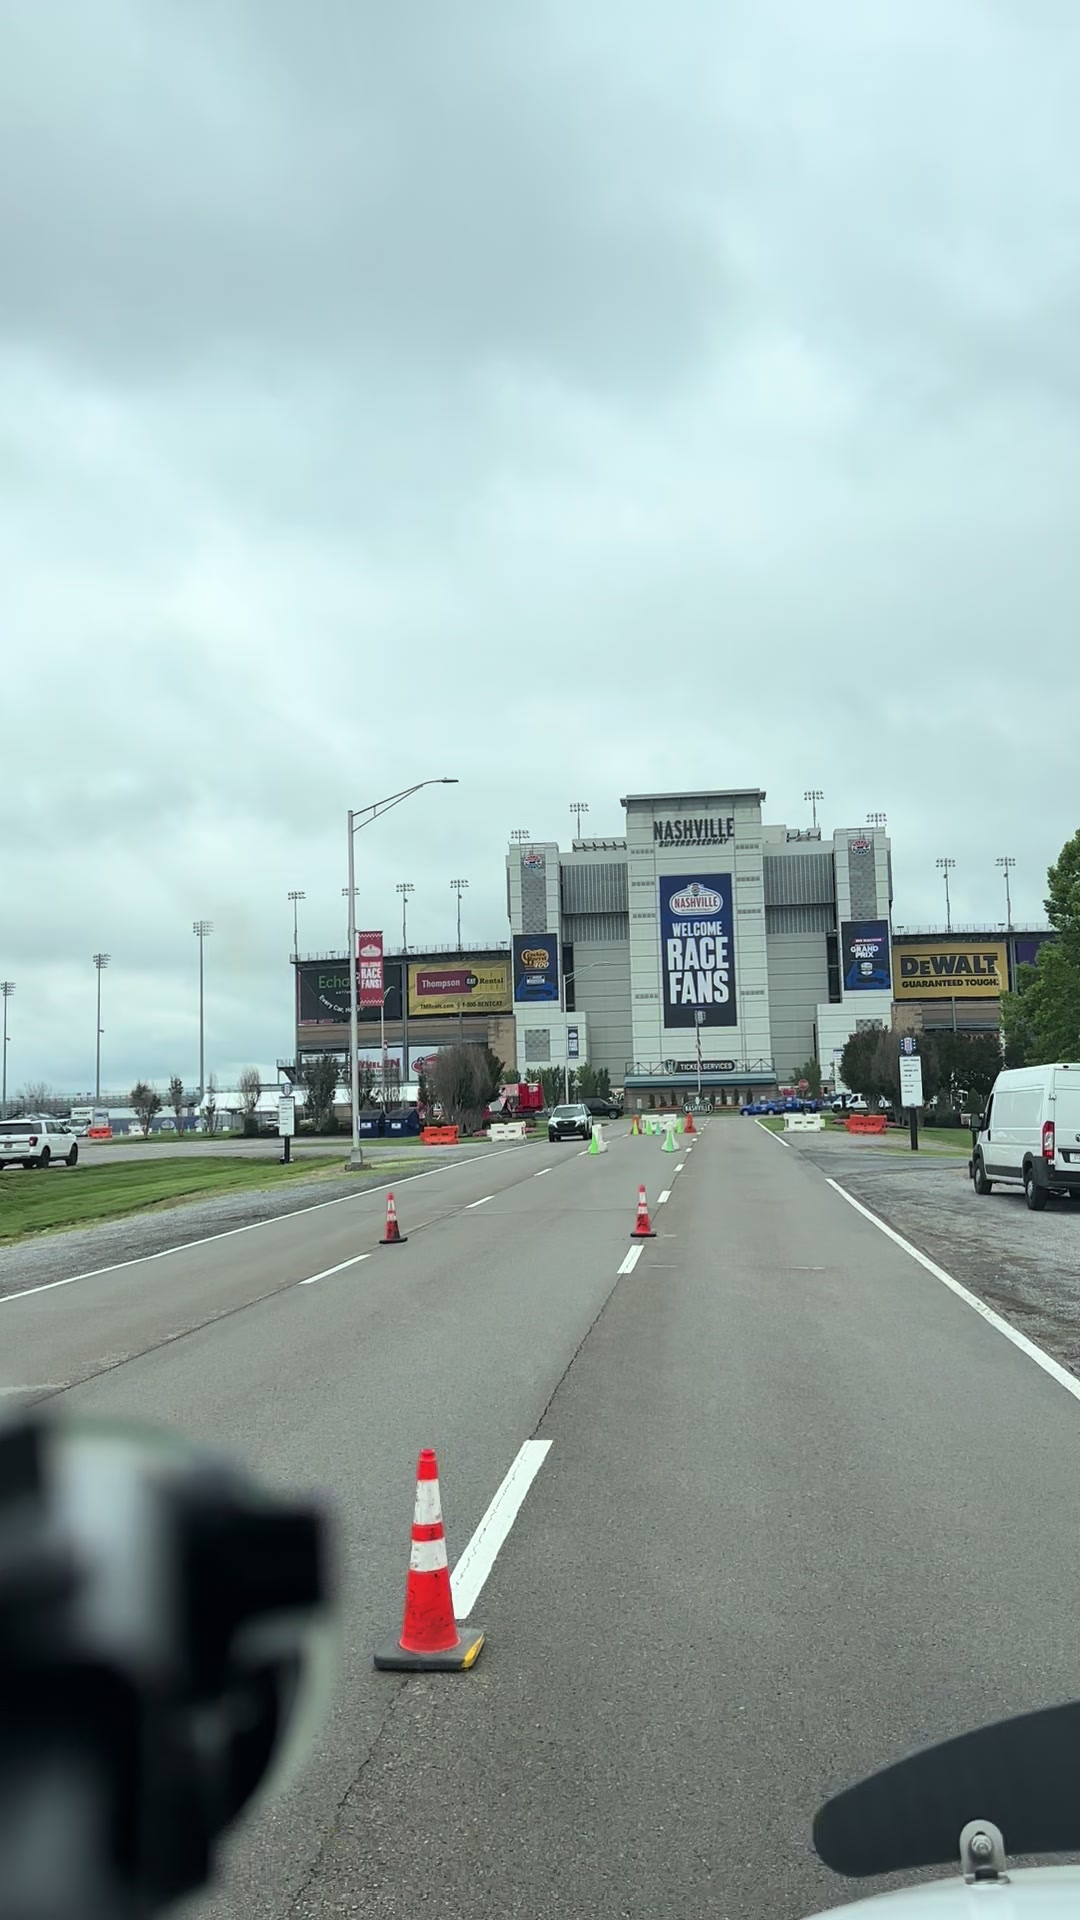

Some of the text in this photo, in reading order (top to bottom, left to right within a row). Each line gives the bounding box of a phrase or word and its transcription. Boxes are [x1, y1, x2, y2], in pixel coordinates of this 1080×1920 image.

[654, 818, 734, 840] NASHVILLE
[659, 838, 729, 847] SUPERSPEEDWAY
[674, 896, 719, 908] NASHVILLE
[672, 921, 723, 937] WELCOME
[667, 937, 730, 971] RACE
[850, 945, 879, 953] GRAND
[361, 968, 382, 979] RACE
[361, 979, 382, 989] FANS!
[421, 979, 460, 989] Thompson
[479, 977, 503, 985] Rental
[669, 970, 729, 1004] FANS
[902, 979, 963, 988] GUARANTEED
[319, 994, 333, 1009] Every
[333, 1004, 344, 1013] Car,
[680, 1063, 701, 1071] TICKE
[703, 1062, 733, 1070] SERVICES
